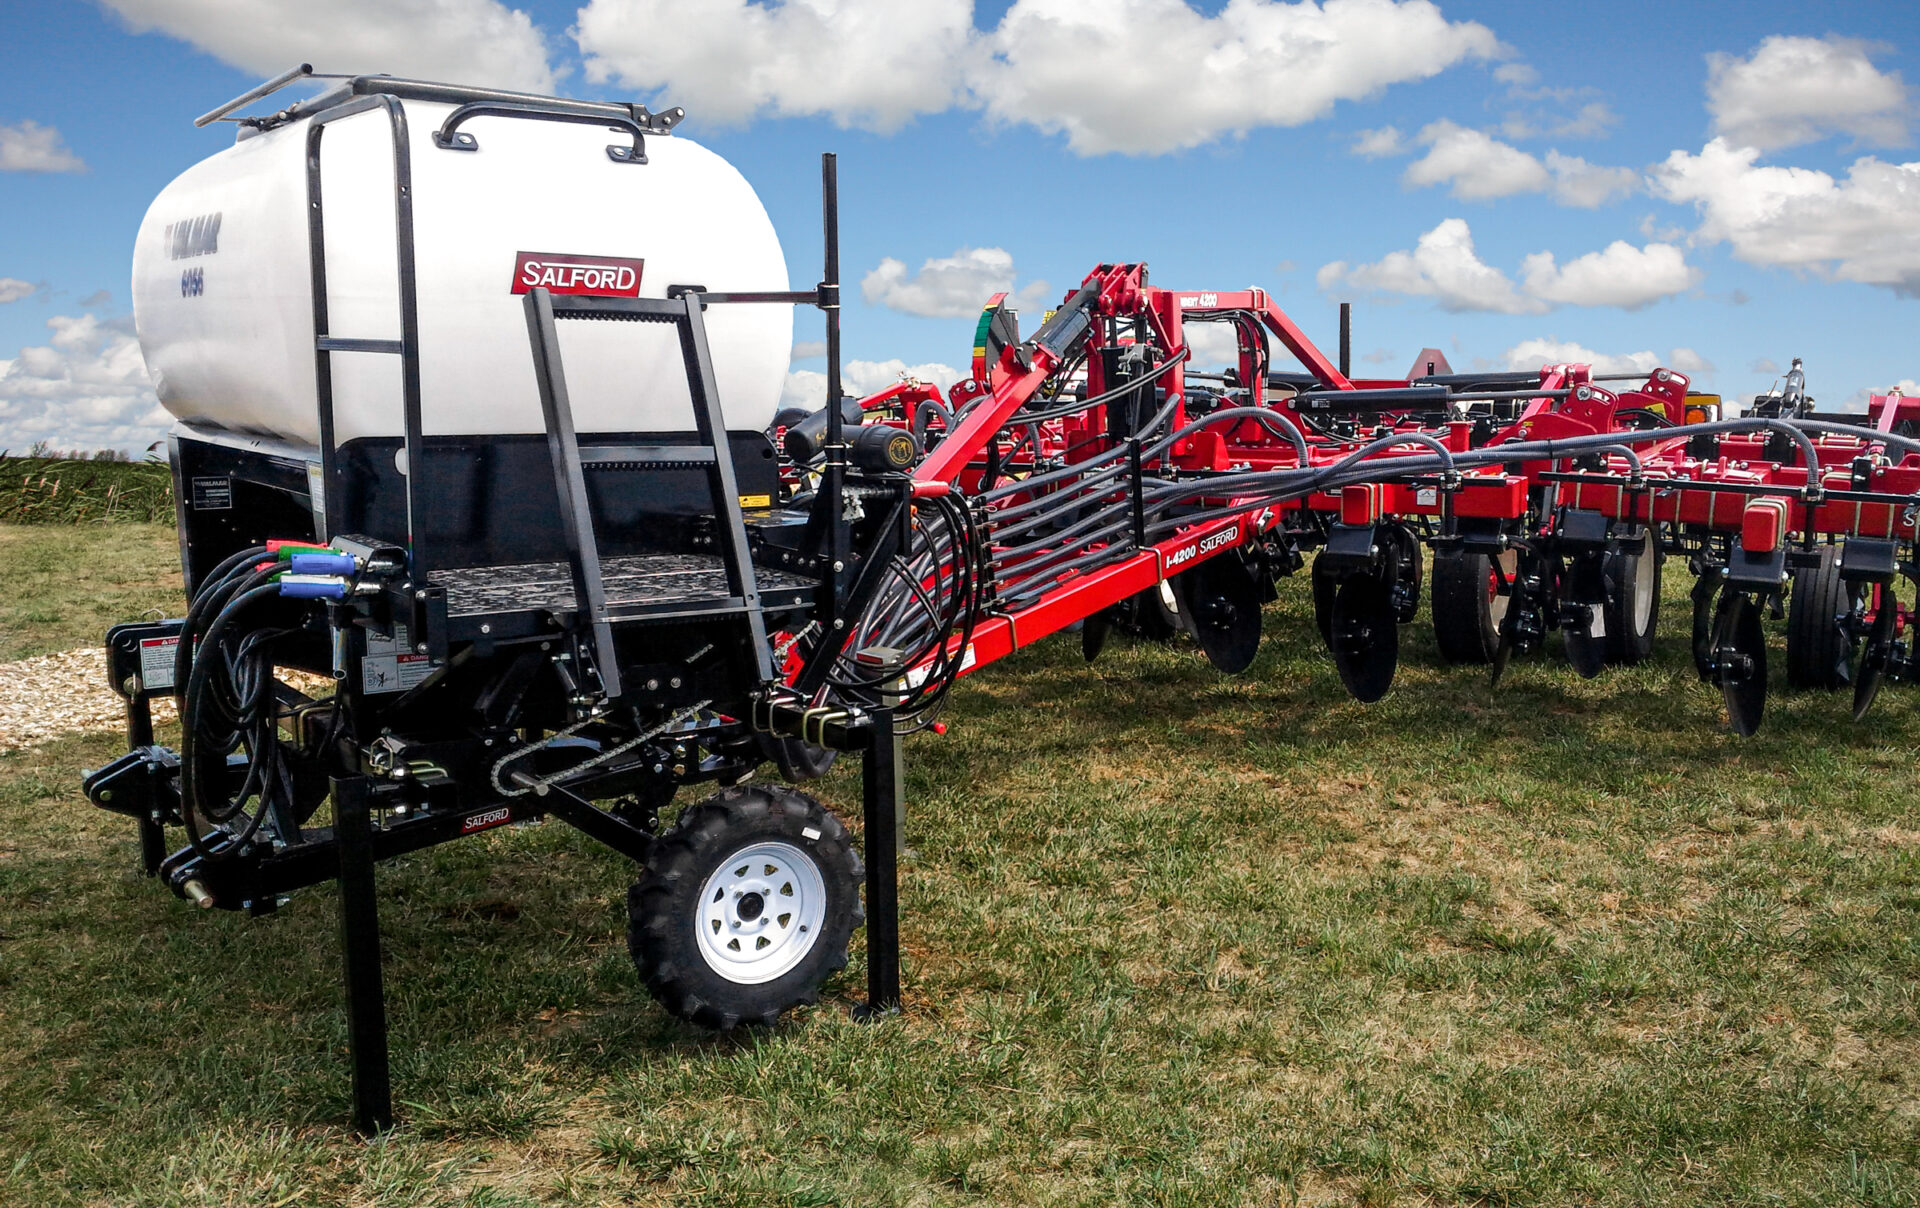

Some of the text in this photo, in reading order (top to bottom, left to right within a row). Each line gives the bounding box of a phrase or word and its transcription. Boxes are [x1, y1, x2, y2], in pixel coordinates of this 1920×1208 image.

[521, 261, 636, 290] SALFORD
[1200, 293, 1217, 307] 4200
[1166, 526, 1238, 569] I-4200 SALFORD
[465, 808, 509, 829] SALFORD
